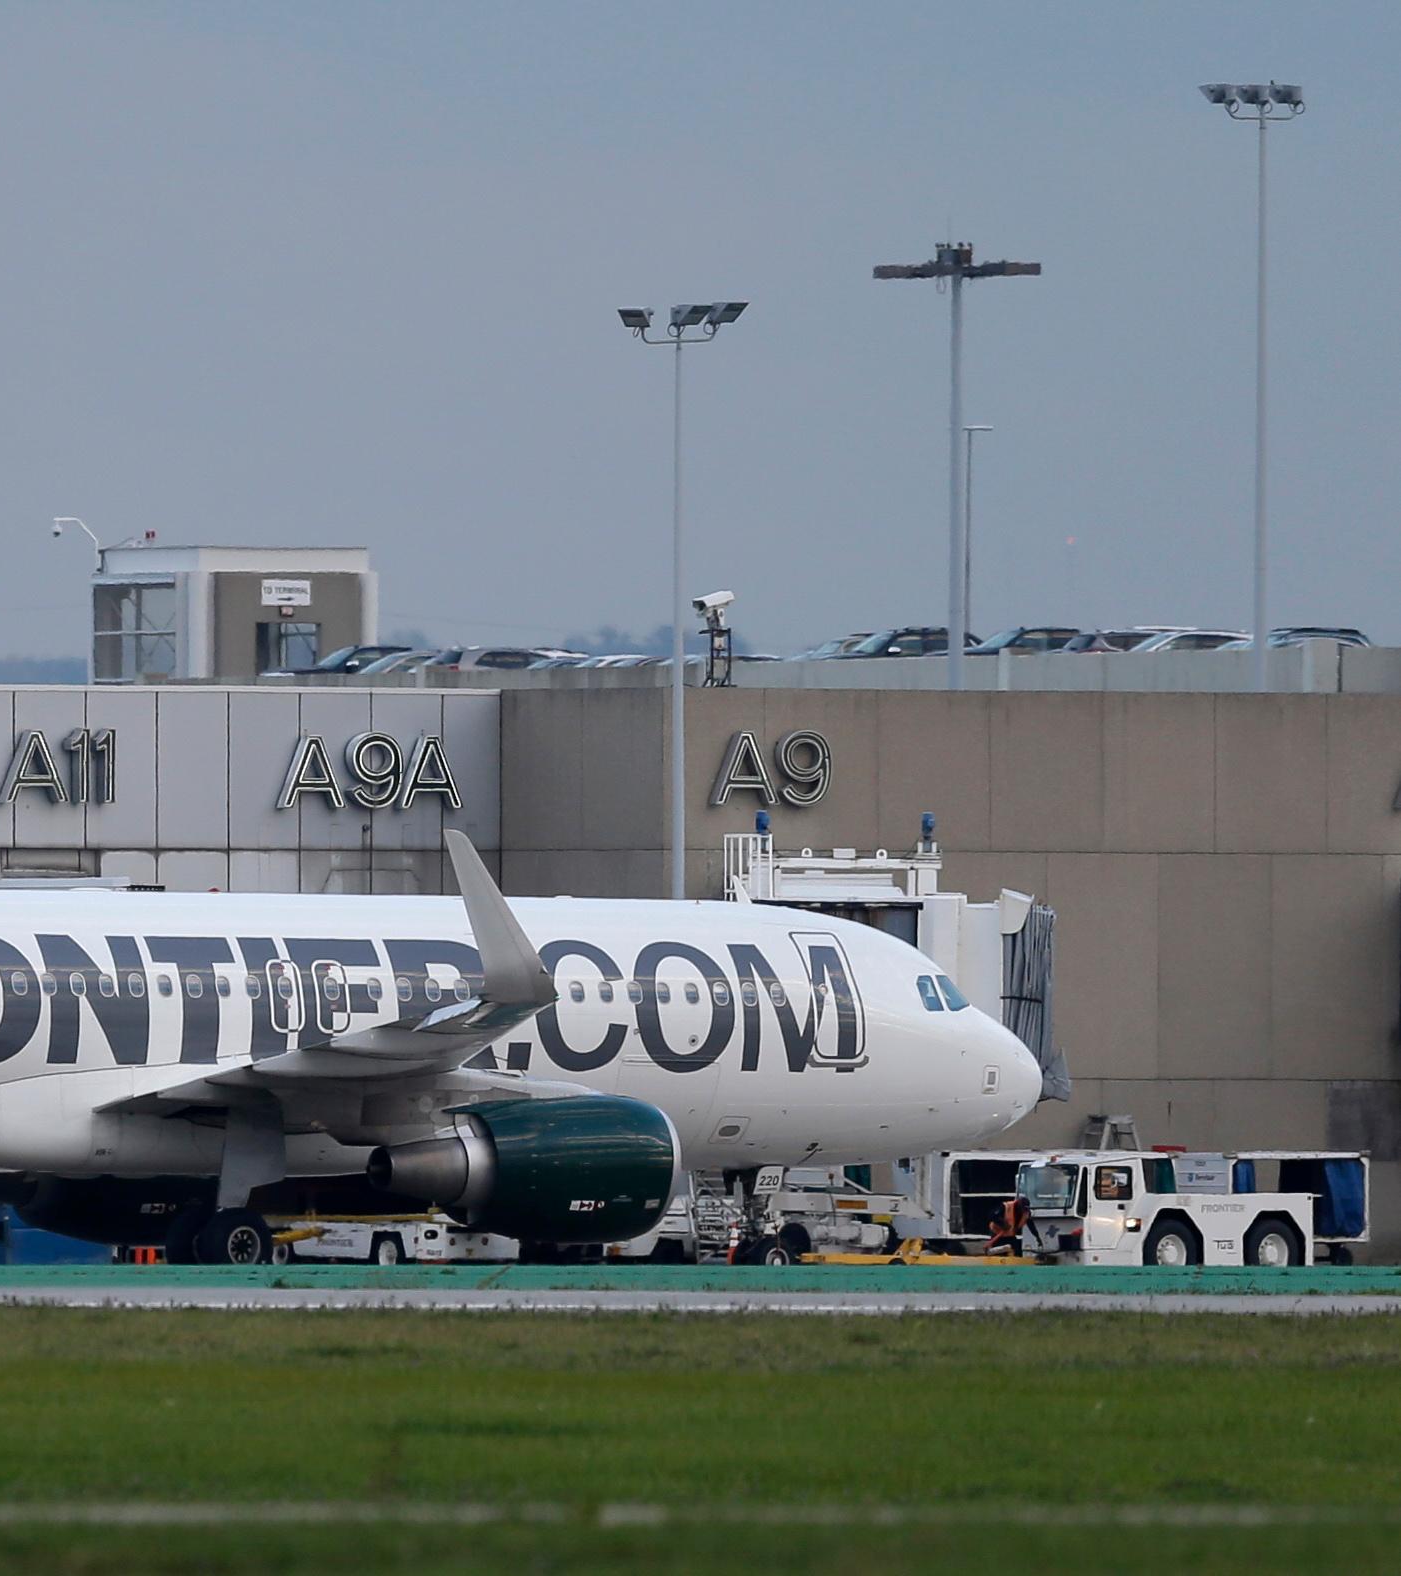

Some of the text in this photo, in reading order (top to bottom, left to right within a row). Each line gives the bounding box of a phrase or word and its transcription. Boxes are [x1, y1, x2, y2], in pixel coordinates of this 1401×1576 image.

[262, 586, 273, 595] TO
[0, 728, 116, 804] A11
[276, 731, 463, 809] A9A
[708, 729, 832, 808] A9
[759, 1175, 780, 1186] 220
[1201, 1203, 1245, 1213] FRONTIER
